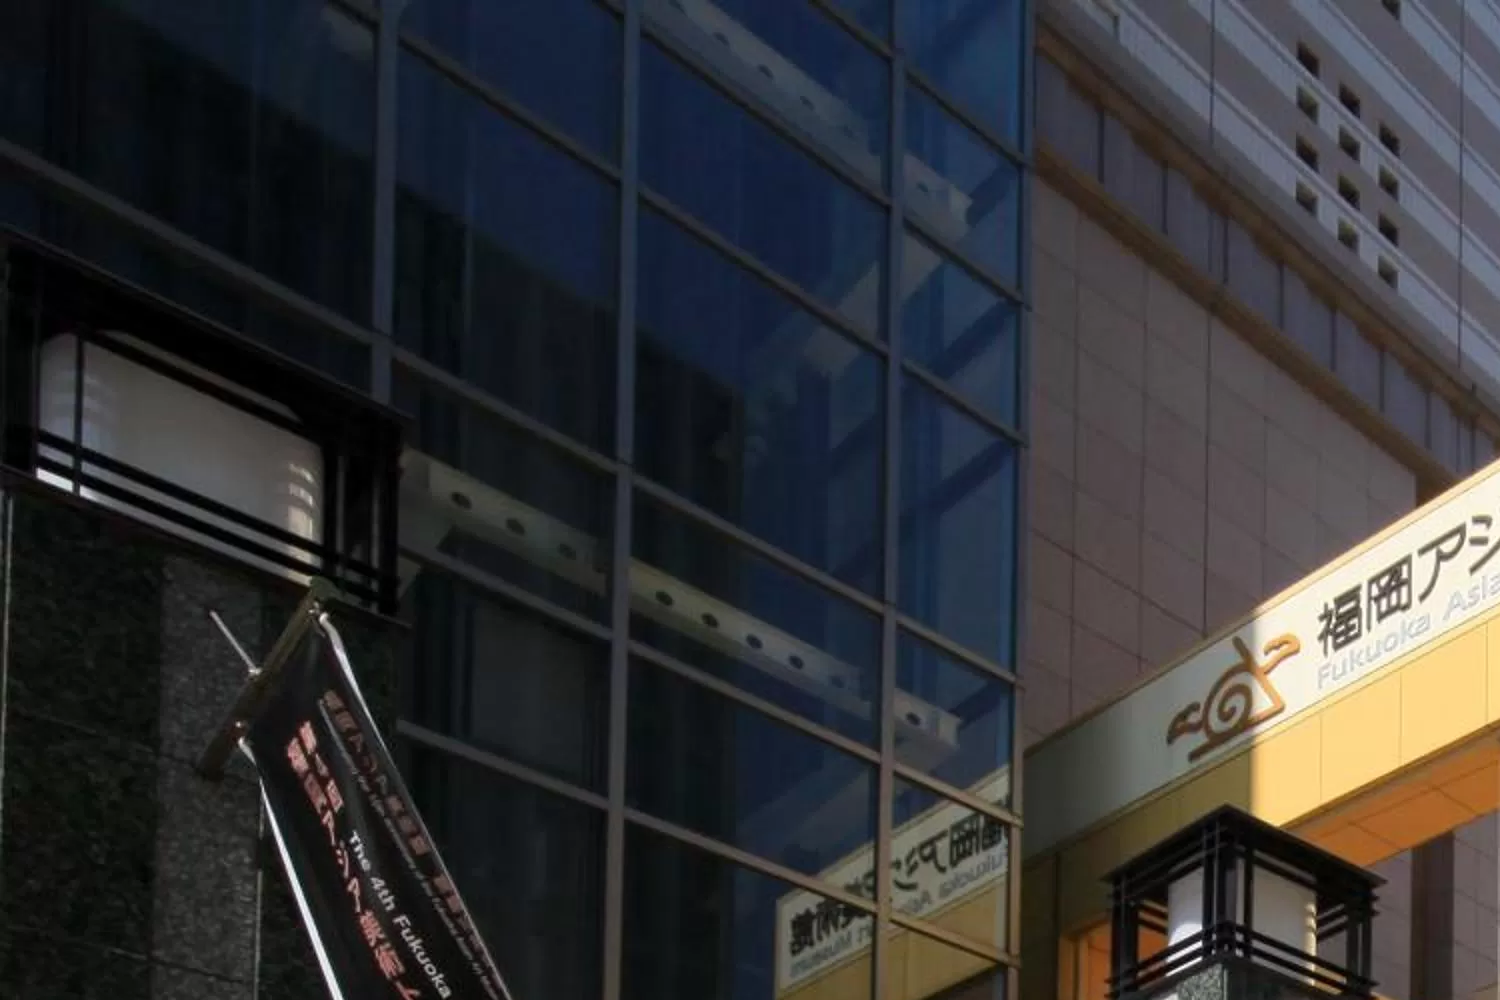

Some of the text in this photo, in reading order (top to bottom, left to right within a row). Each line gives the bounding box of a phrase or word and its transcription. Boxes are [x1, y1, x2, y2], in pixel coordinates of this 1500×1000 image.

[1316, 610, 1431, 690] Fukuoka
[350, 830, 371, 872] The
[370, 876, 396, 912] 4th
[393, 914, 453, 1000] Fukuoka
